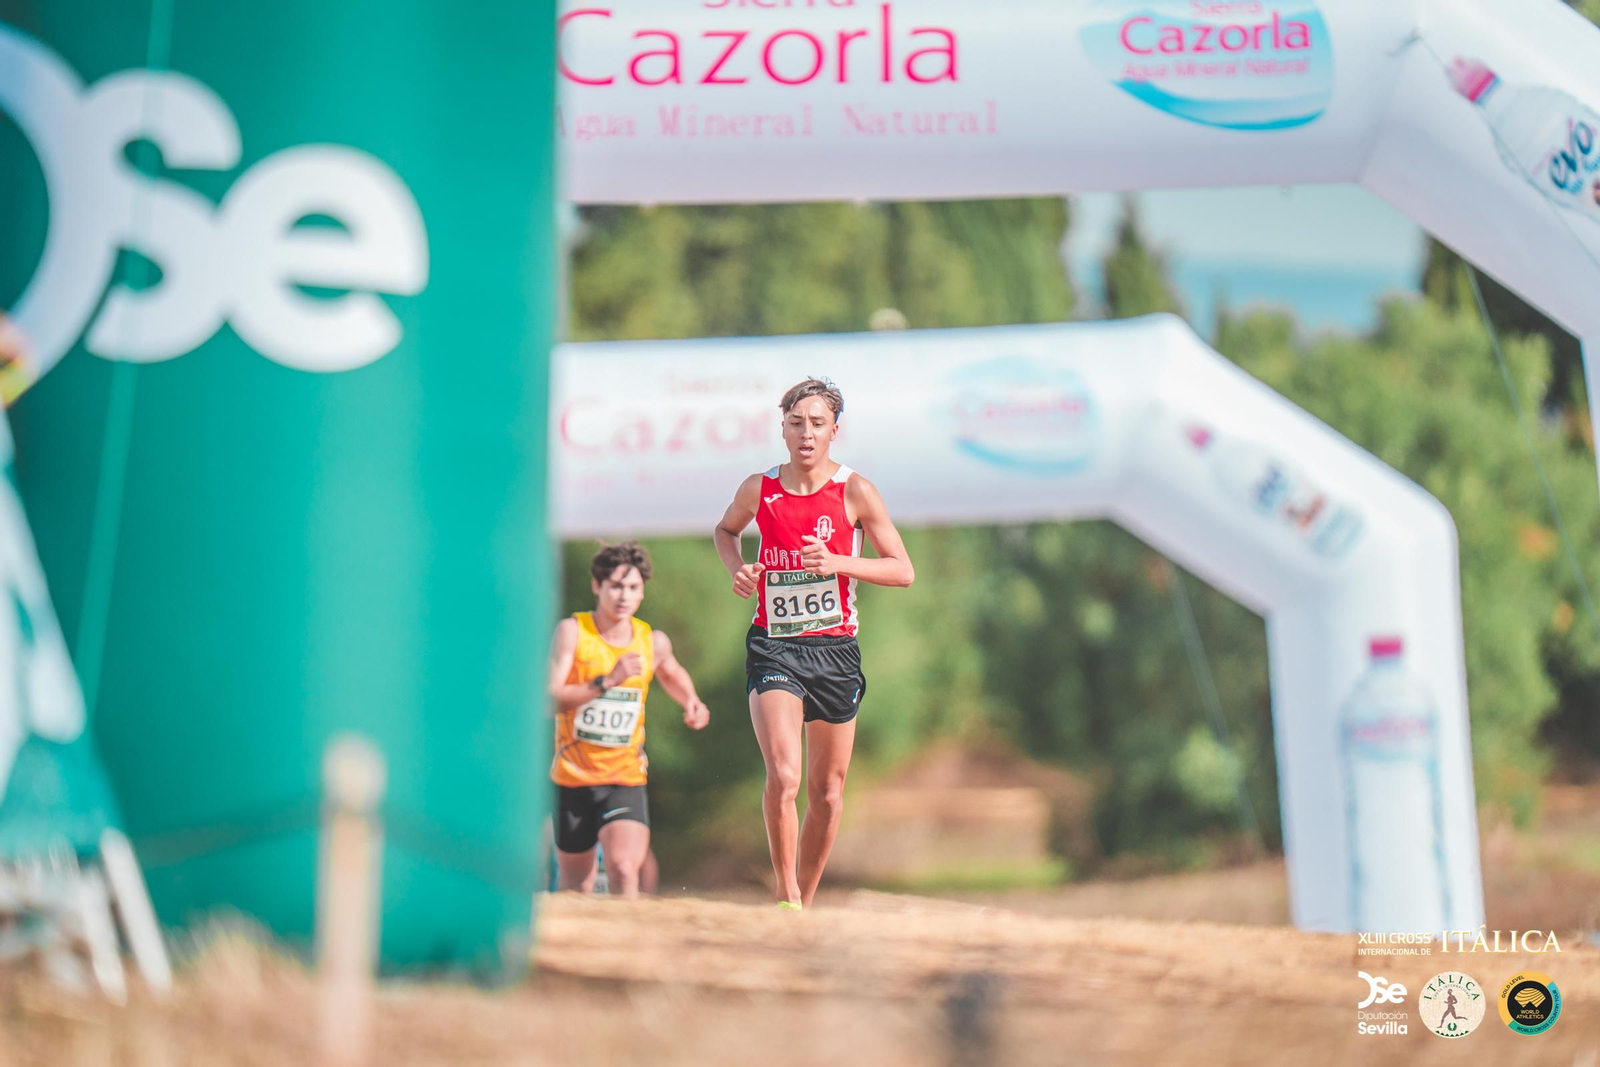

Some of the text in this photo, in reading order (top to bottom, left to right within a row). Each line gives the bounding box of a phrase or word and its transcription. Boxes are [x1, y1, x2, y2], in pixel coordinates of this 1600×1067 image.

[557, 3, 959, 86] Cazorla
[1119, 11, 1311, 55] Cazorla
[656, 104, 815, 137] Mineral
[842, 101, 999, 135] Natural
[772, 590, 836, 618] 8166
[582, 706, 634, 729] 6107
